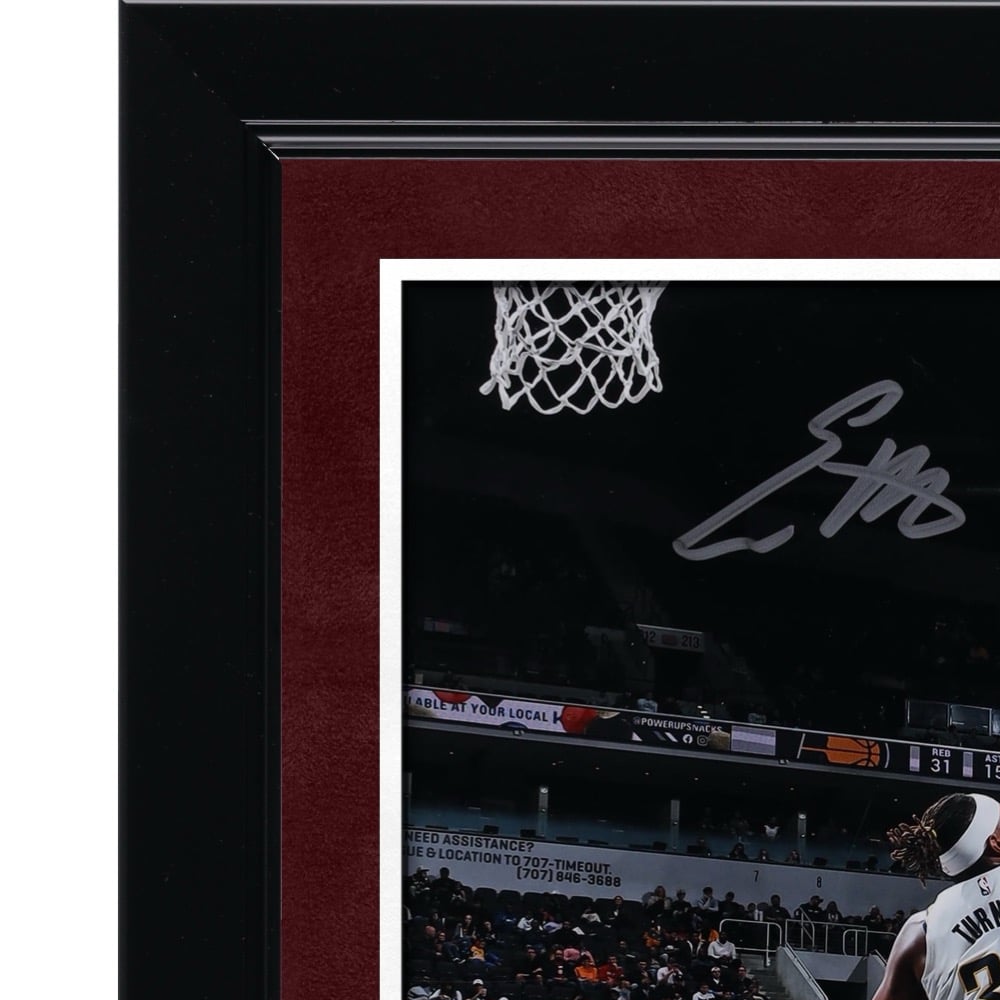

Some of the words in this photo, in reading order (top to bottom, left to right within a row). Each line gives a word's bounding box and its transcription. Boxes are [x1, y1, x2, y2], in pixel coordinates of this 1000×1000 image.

[451, 702, 467, 713] AT
[471, 703, 505, 717] YOUR
[509, 708, 548, 722] LOCAL
[932, 748, 951, 758] REB
[930, 759, 950, 775] 31
[405, 831, 439, 844] NEED
[443, 834, 535, 852] ASSISTANCE?
[426, 847, 436, 858] &
[439, 848, 501, 865] LOCATION
[504, 855, 520, 866] TO
[556, 869, 621, 888] 846-3688
